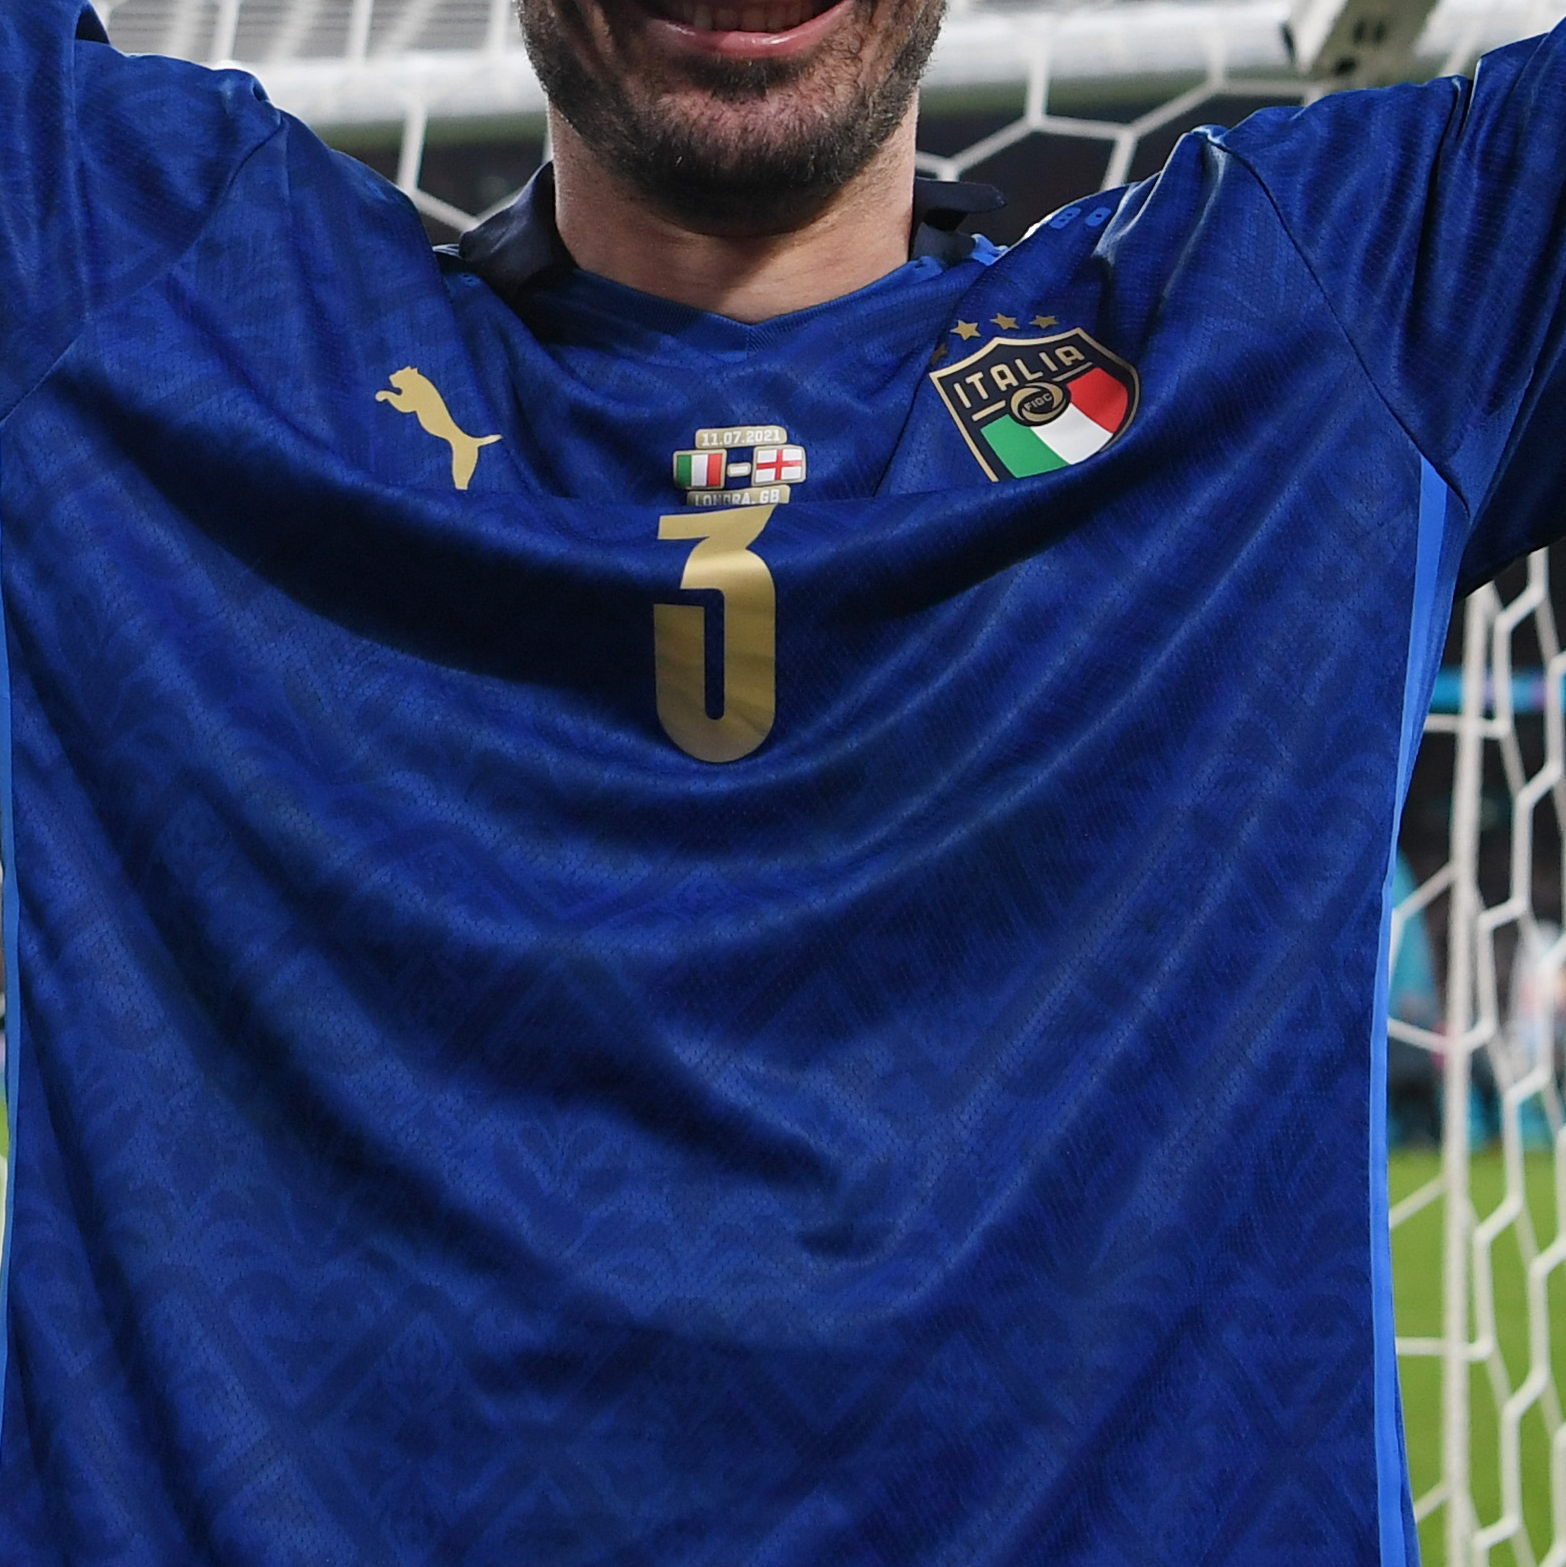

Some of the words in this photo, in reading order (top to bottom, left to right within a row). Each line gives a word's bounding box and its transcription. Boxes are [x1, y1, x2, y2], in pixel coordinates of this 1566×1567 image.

[953, 345, 1085, 409] ITALIA
[1023, 392, 1053, 412] FIGC
[701, 429, 781, 447] 11.07.2021
[759, 488, 781, 505] GB
[653, 503, 777, 763] 3
